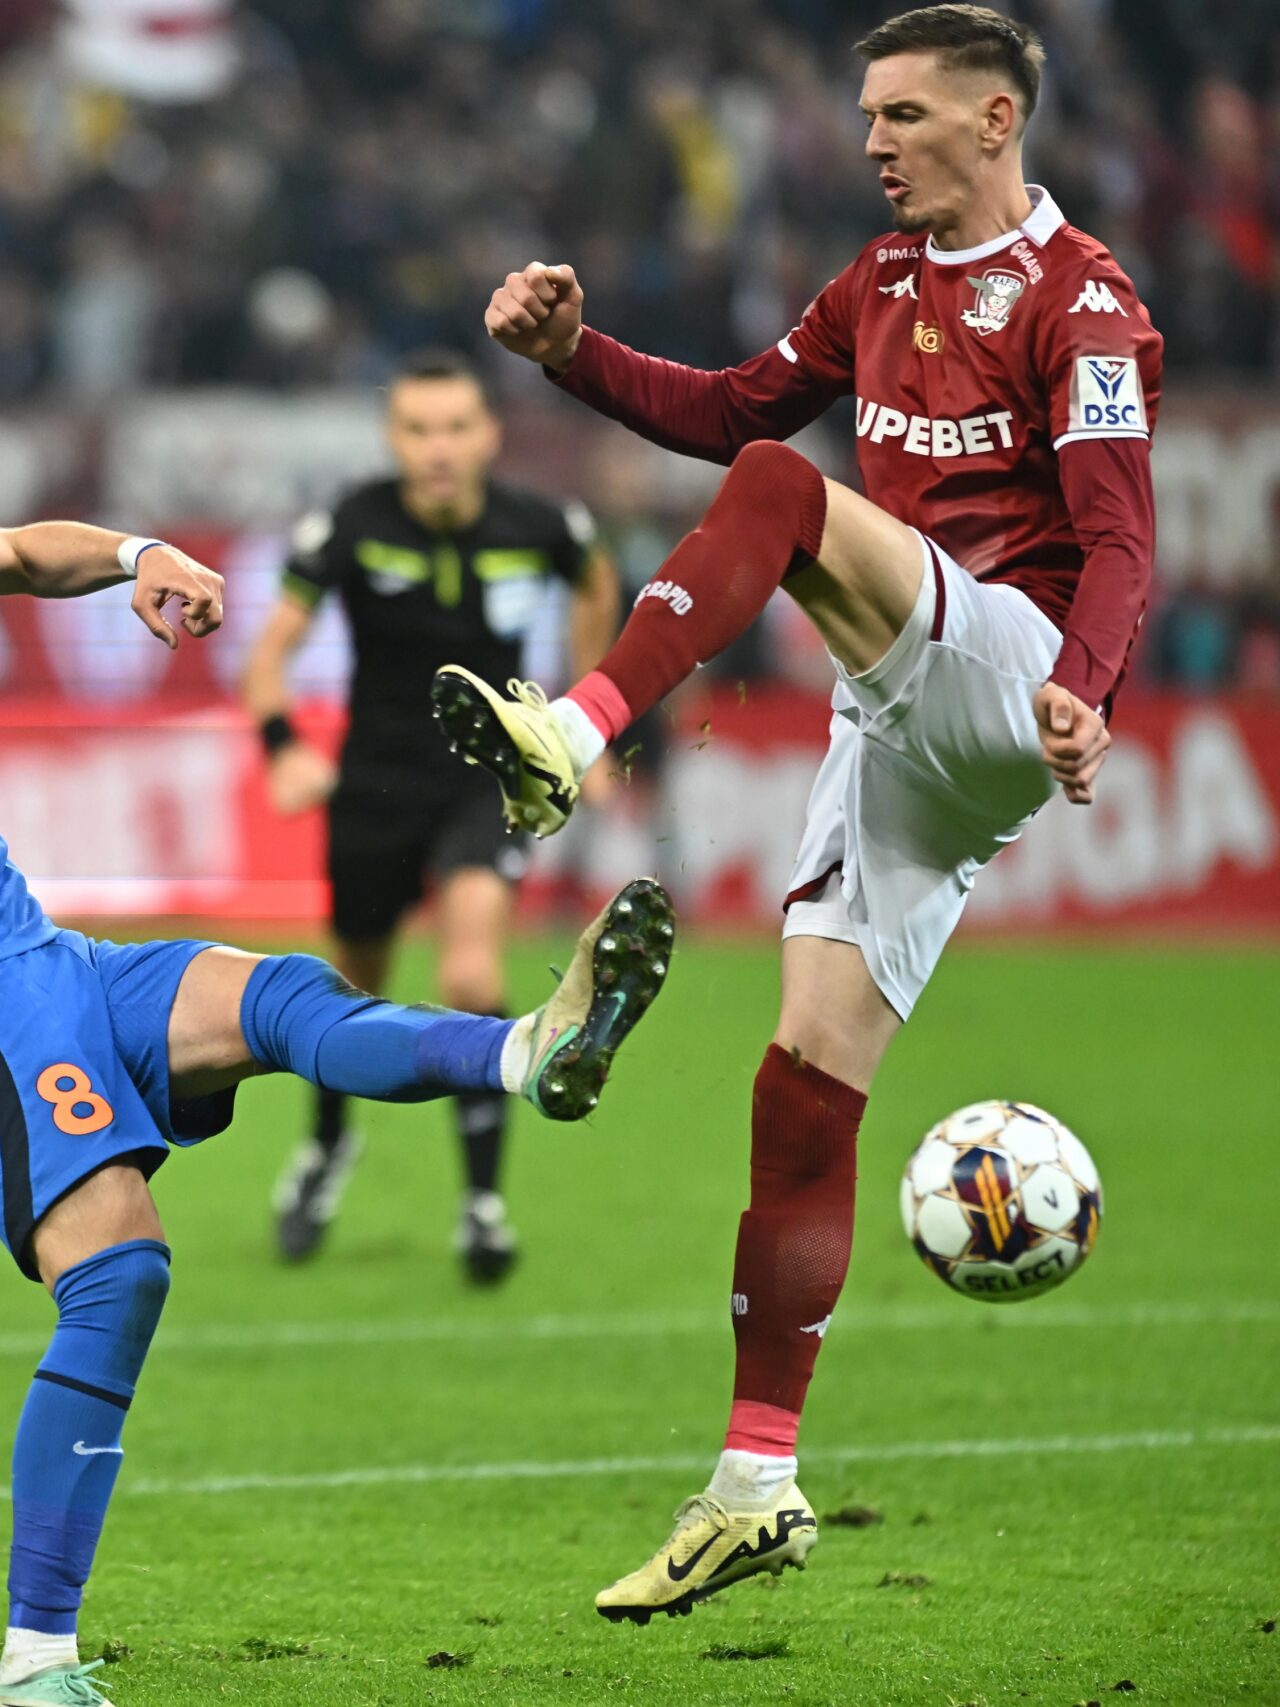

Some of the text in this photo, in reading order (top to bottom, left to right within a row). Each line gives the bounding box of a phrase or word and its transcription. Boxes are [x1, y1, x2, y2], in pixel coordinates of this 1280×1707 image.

[1084, 404, 1137, 425] DSC
[36, 1062, 114, 1135] 8
[964, 1250, 1067, 1292] SELECT
